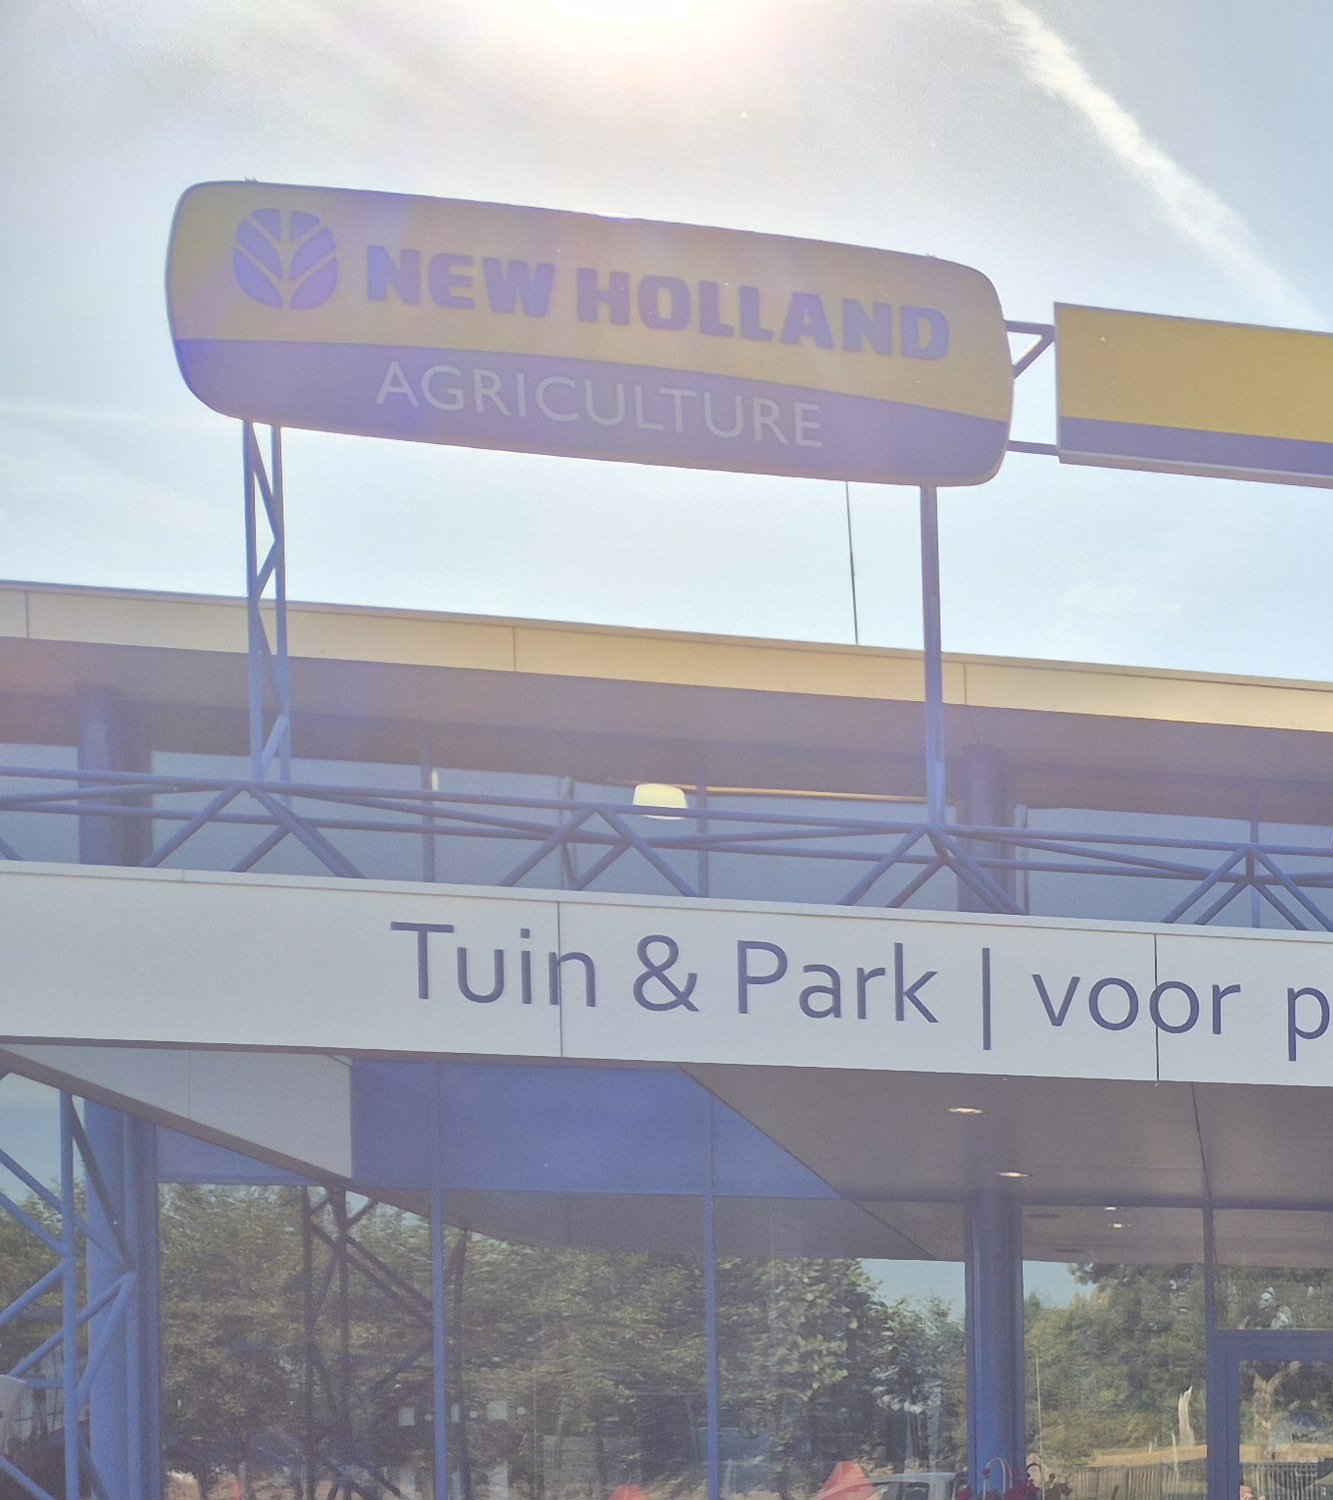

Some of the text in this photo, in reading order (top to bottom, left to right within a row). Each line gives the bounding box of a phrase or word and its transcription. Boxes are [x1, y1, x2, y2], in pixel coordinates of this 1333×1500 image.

[366, 244, 951, 361] NEW HOLLAND
[376, 360, 824, 449] AGRICULTURE
[390, 920, 597, 1008] Tuin
[632, 933, 700, 1013] &
[737, 938, 939, 1024] Park
[1032, 972, 1241, 1036] voor
